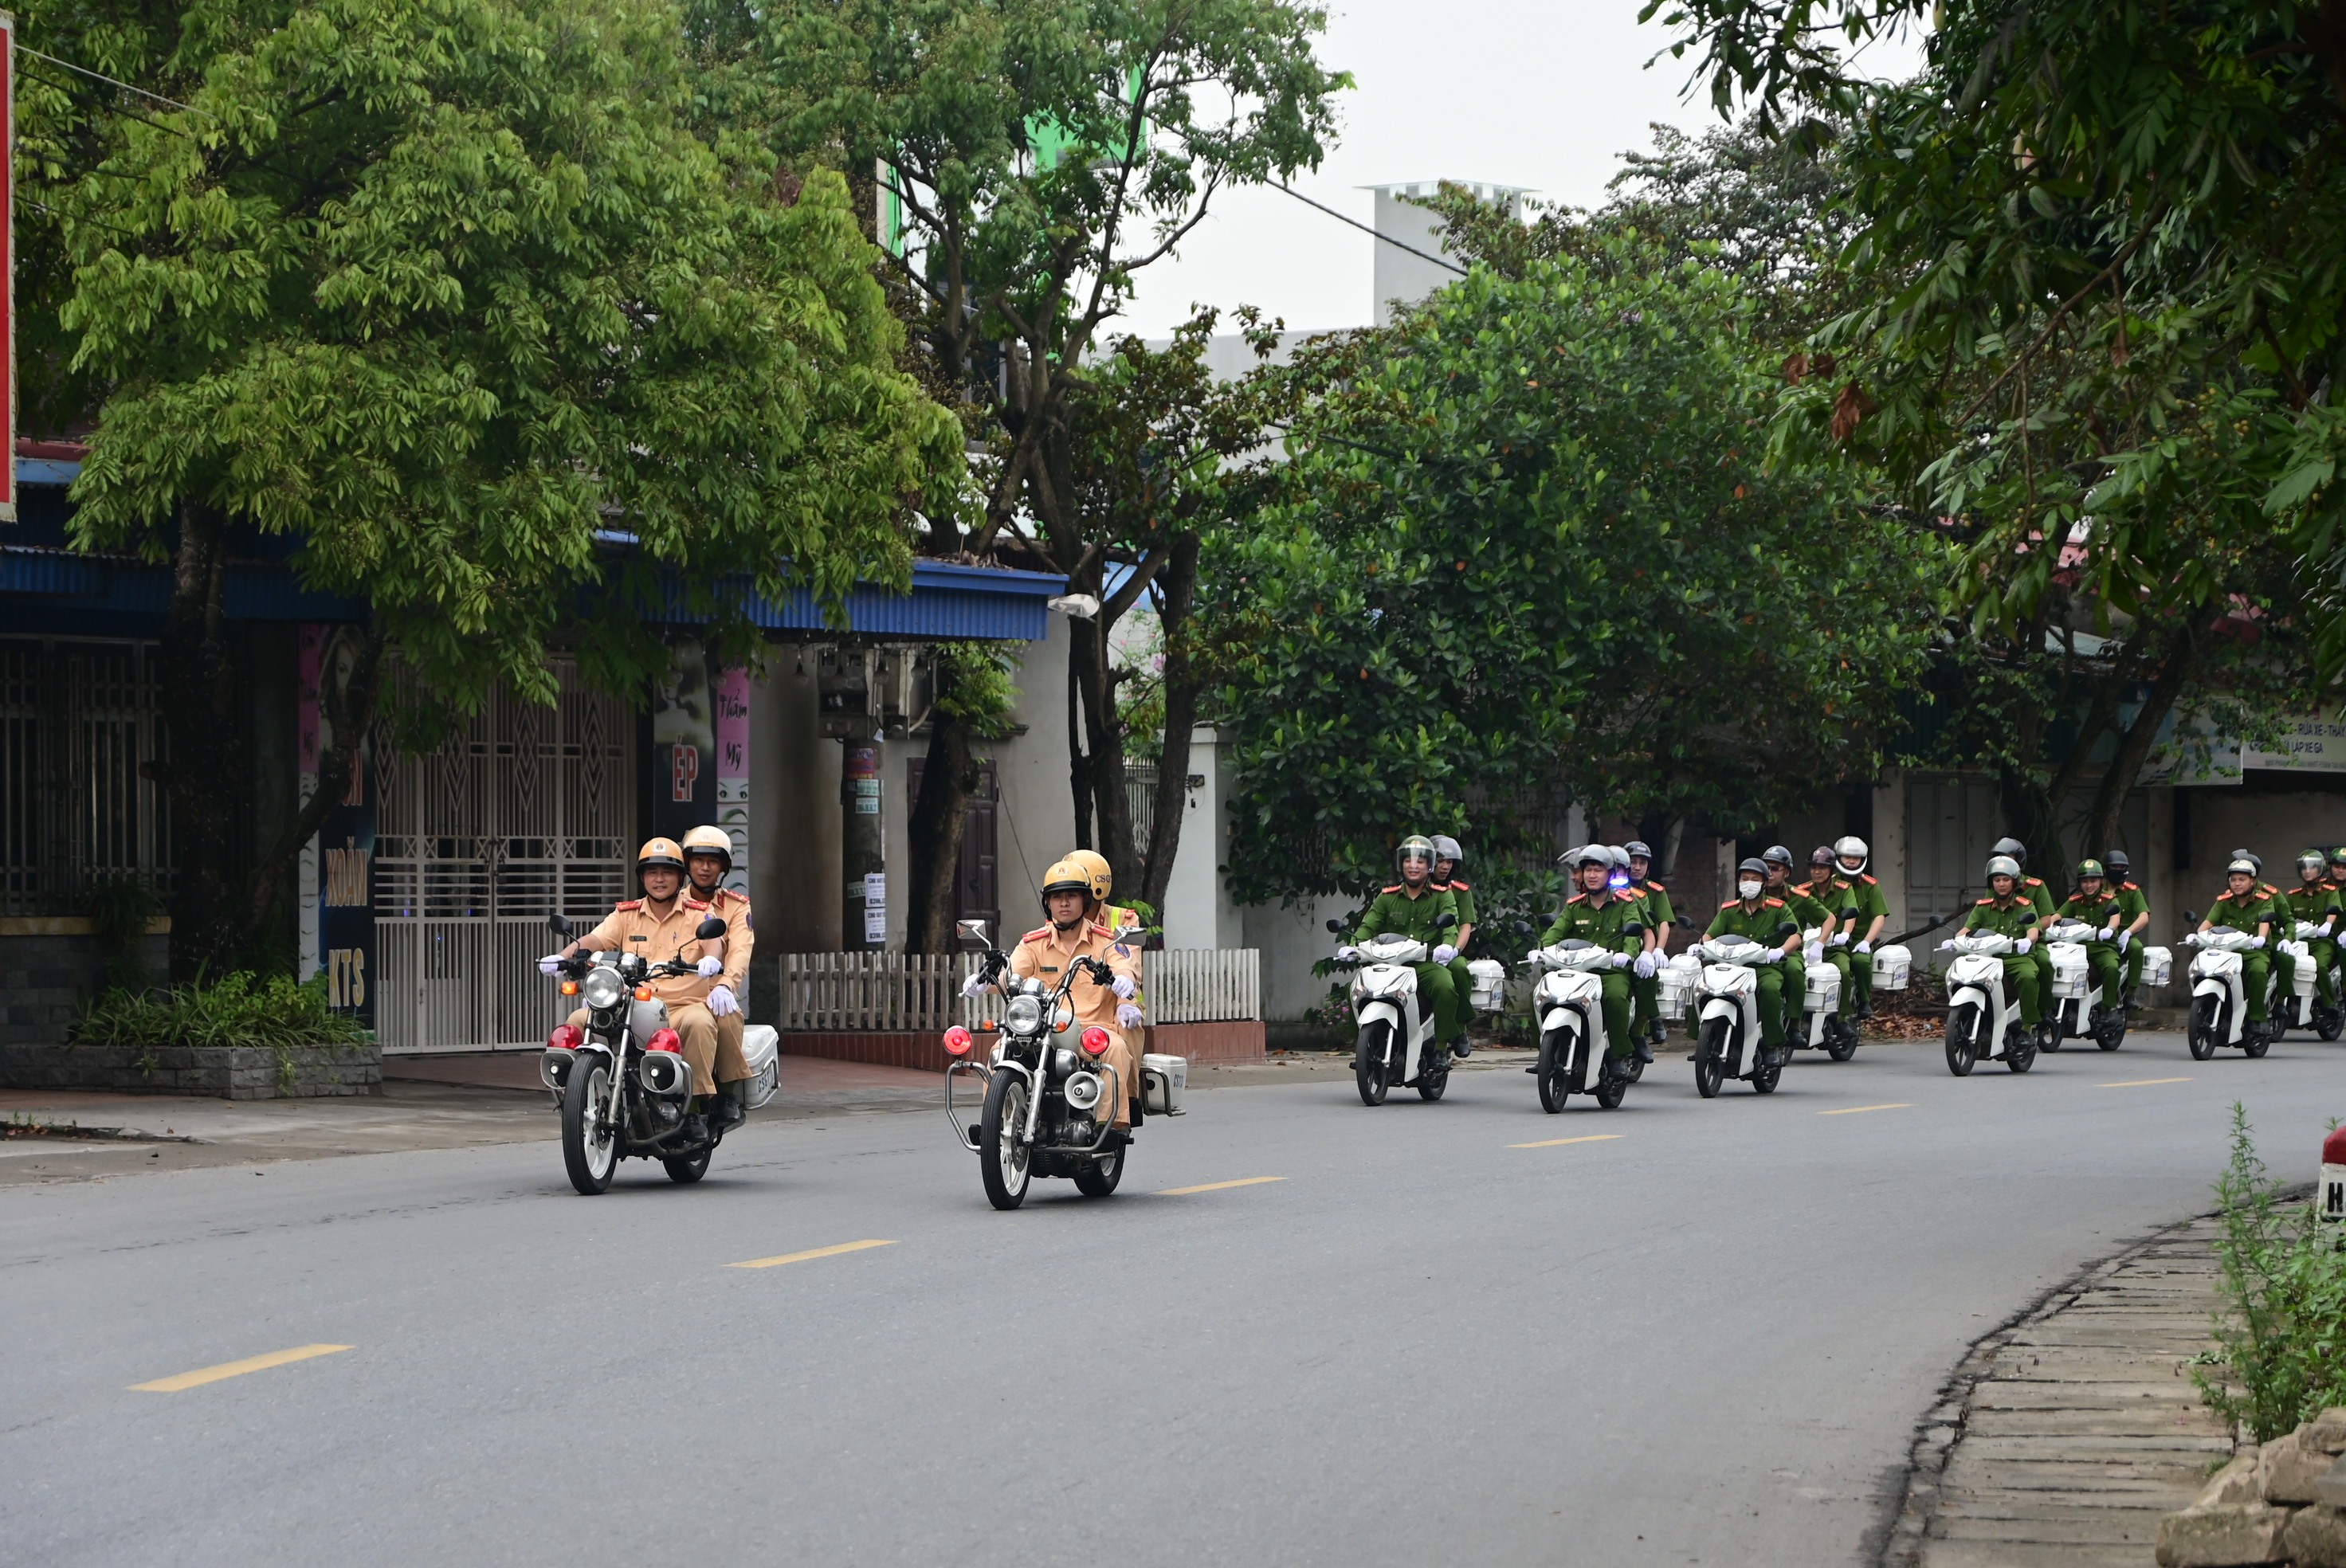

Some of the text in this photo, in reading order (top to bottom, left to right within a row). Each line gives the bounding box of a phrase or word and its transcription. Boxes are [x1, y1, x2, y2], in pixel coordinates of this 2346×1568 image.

[673, 734, 698, 802] ÉP
[725, 741, 742, 771] Mỹ
[325, 836, 367, 907] XOĂN
[1095, 874, 1112, 883] CSG
[328, 947, 365, 1007] KTS
